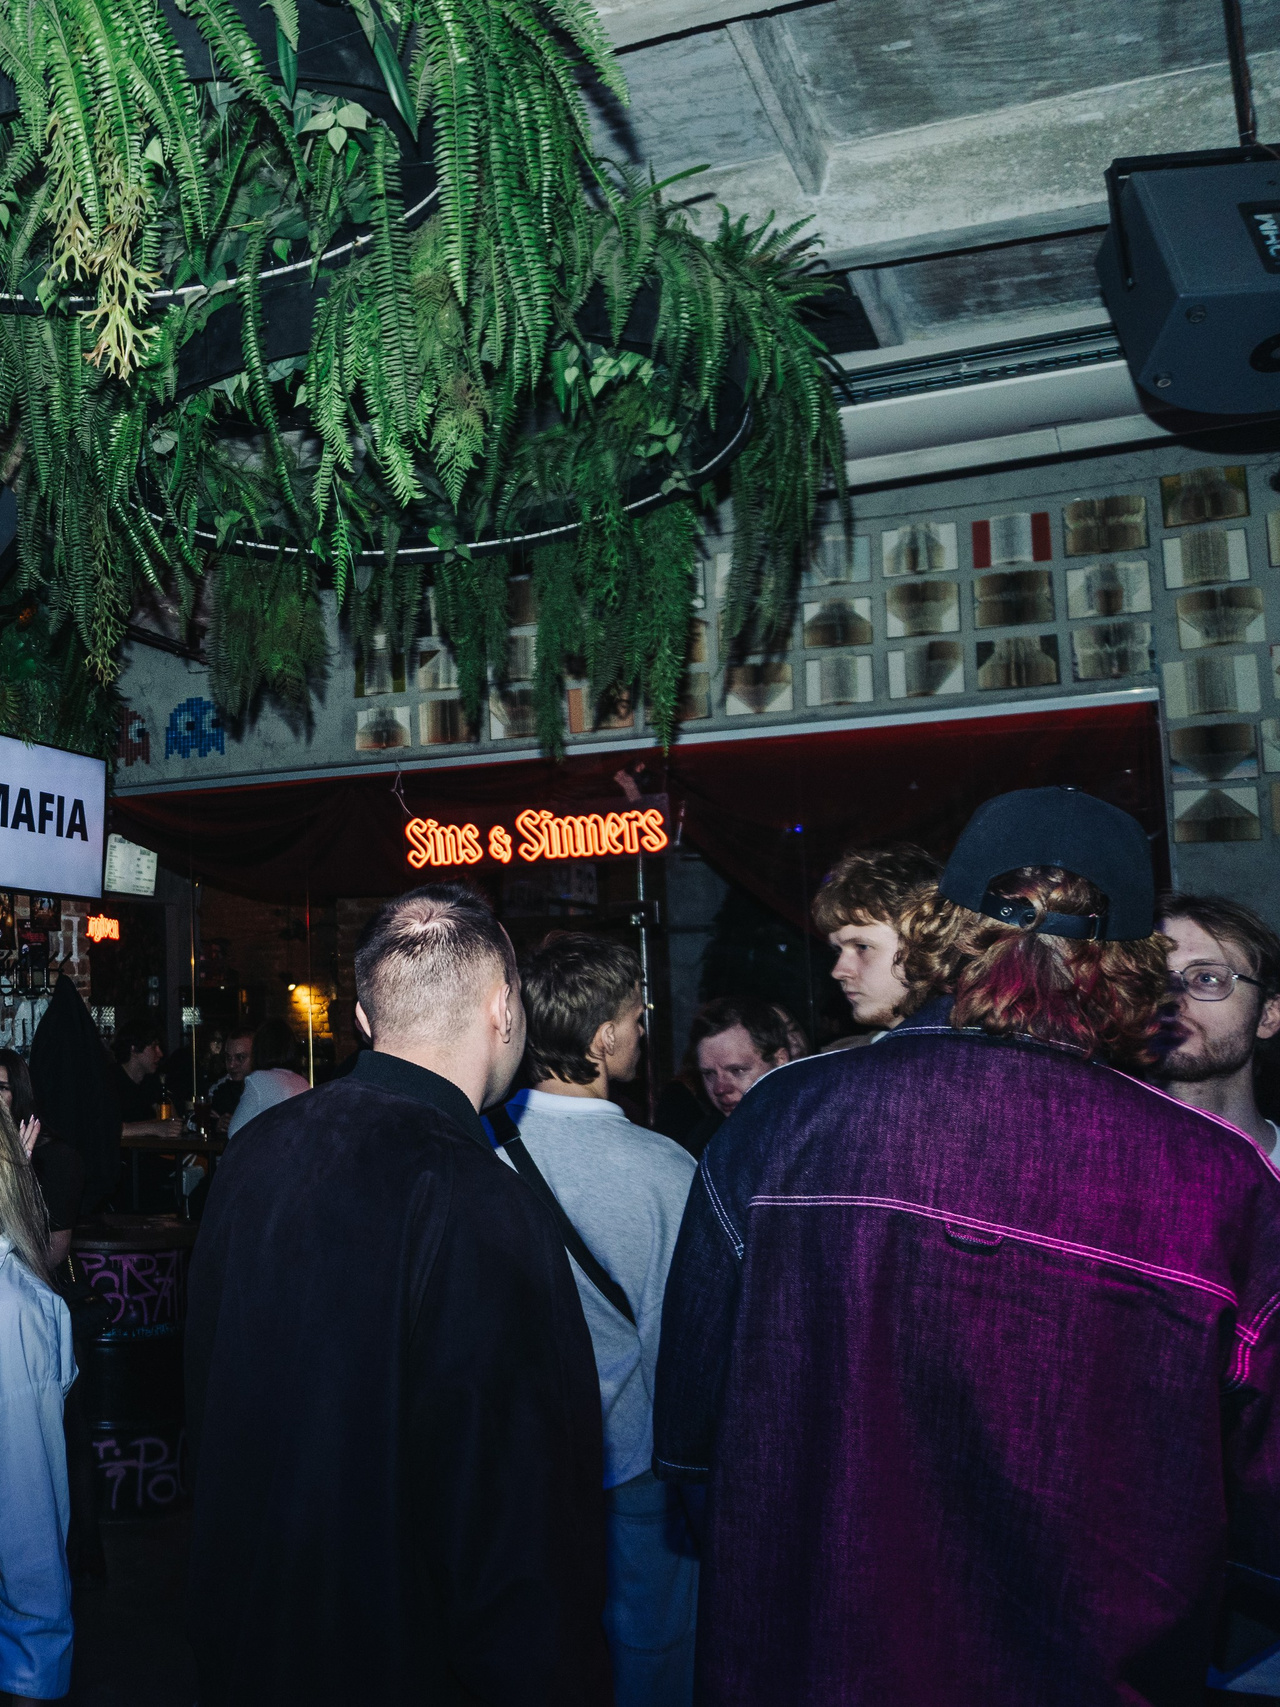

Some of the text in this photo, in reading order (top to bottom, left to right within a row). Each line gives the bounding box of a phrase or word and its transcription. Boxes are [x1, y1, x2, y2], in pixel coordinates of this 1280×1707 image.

[405, 808, 669, 869] Sins & Sinners
